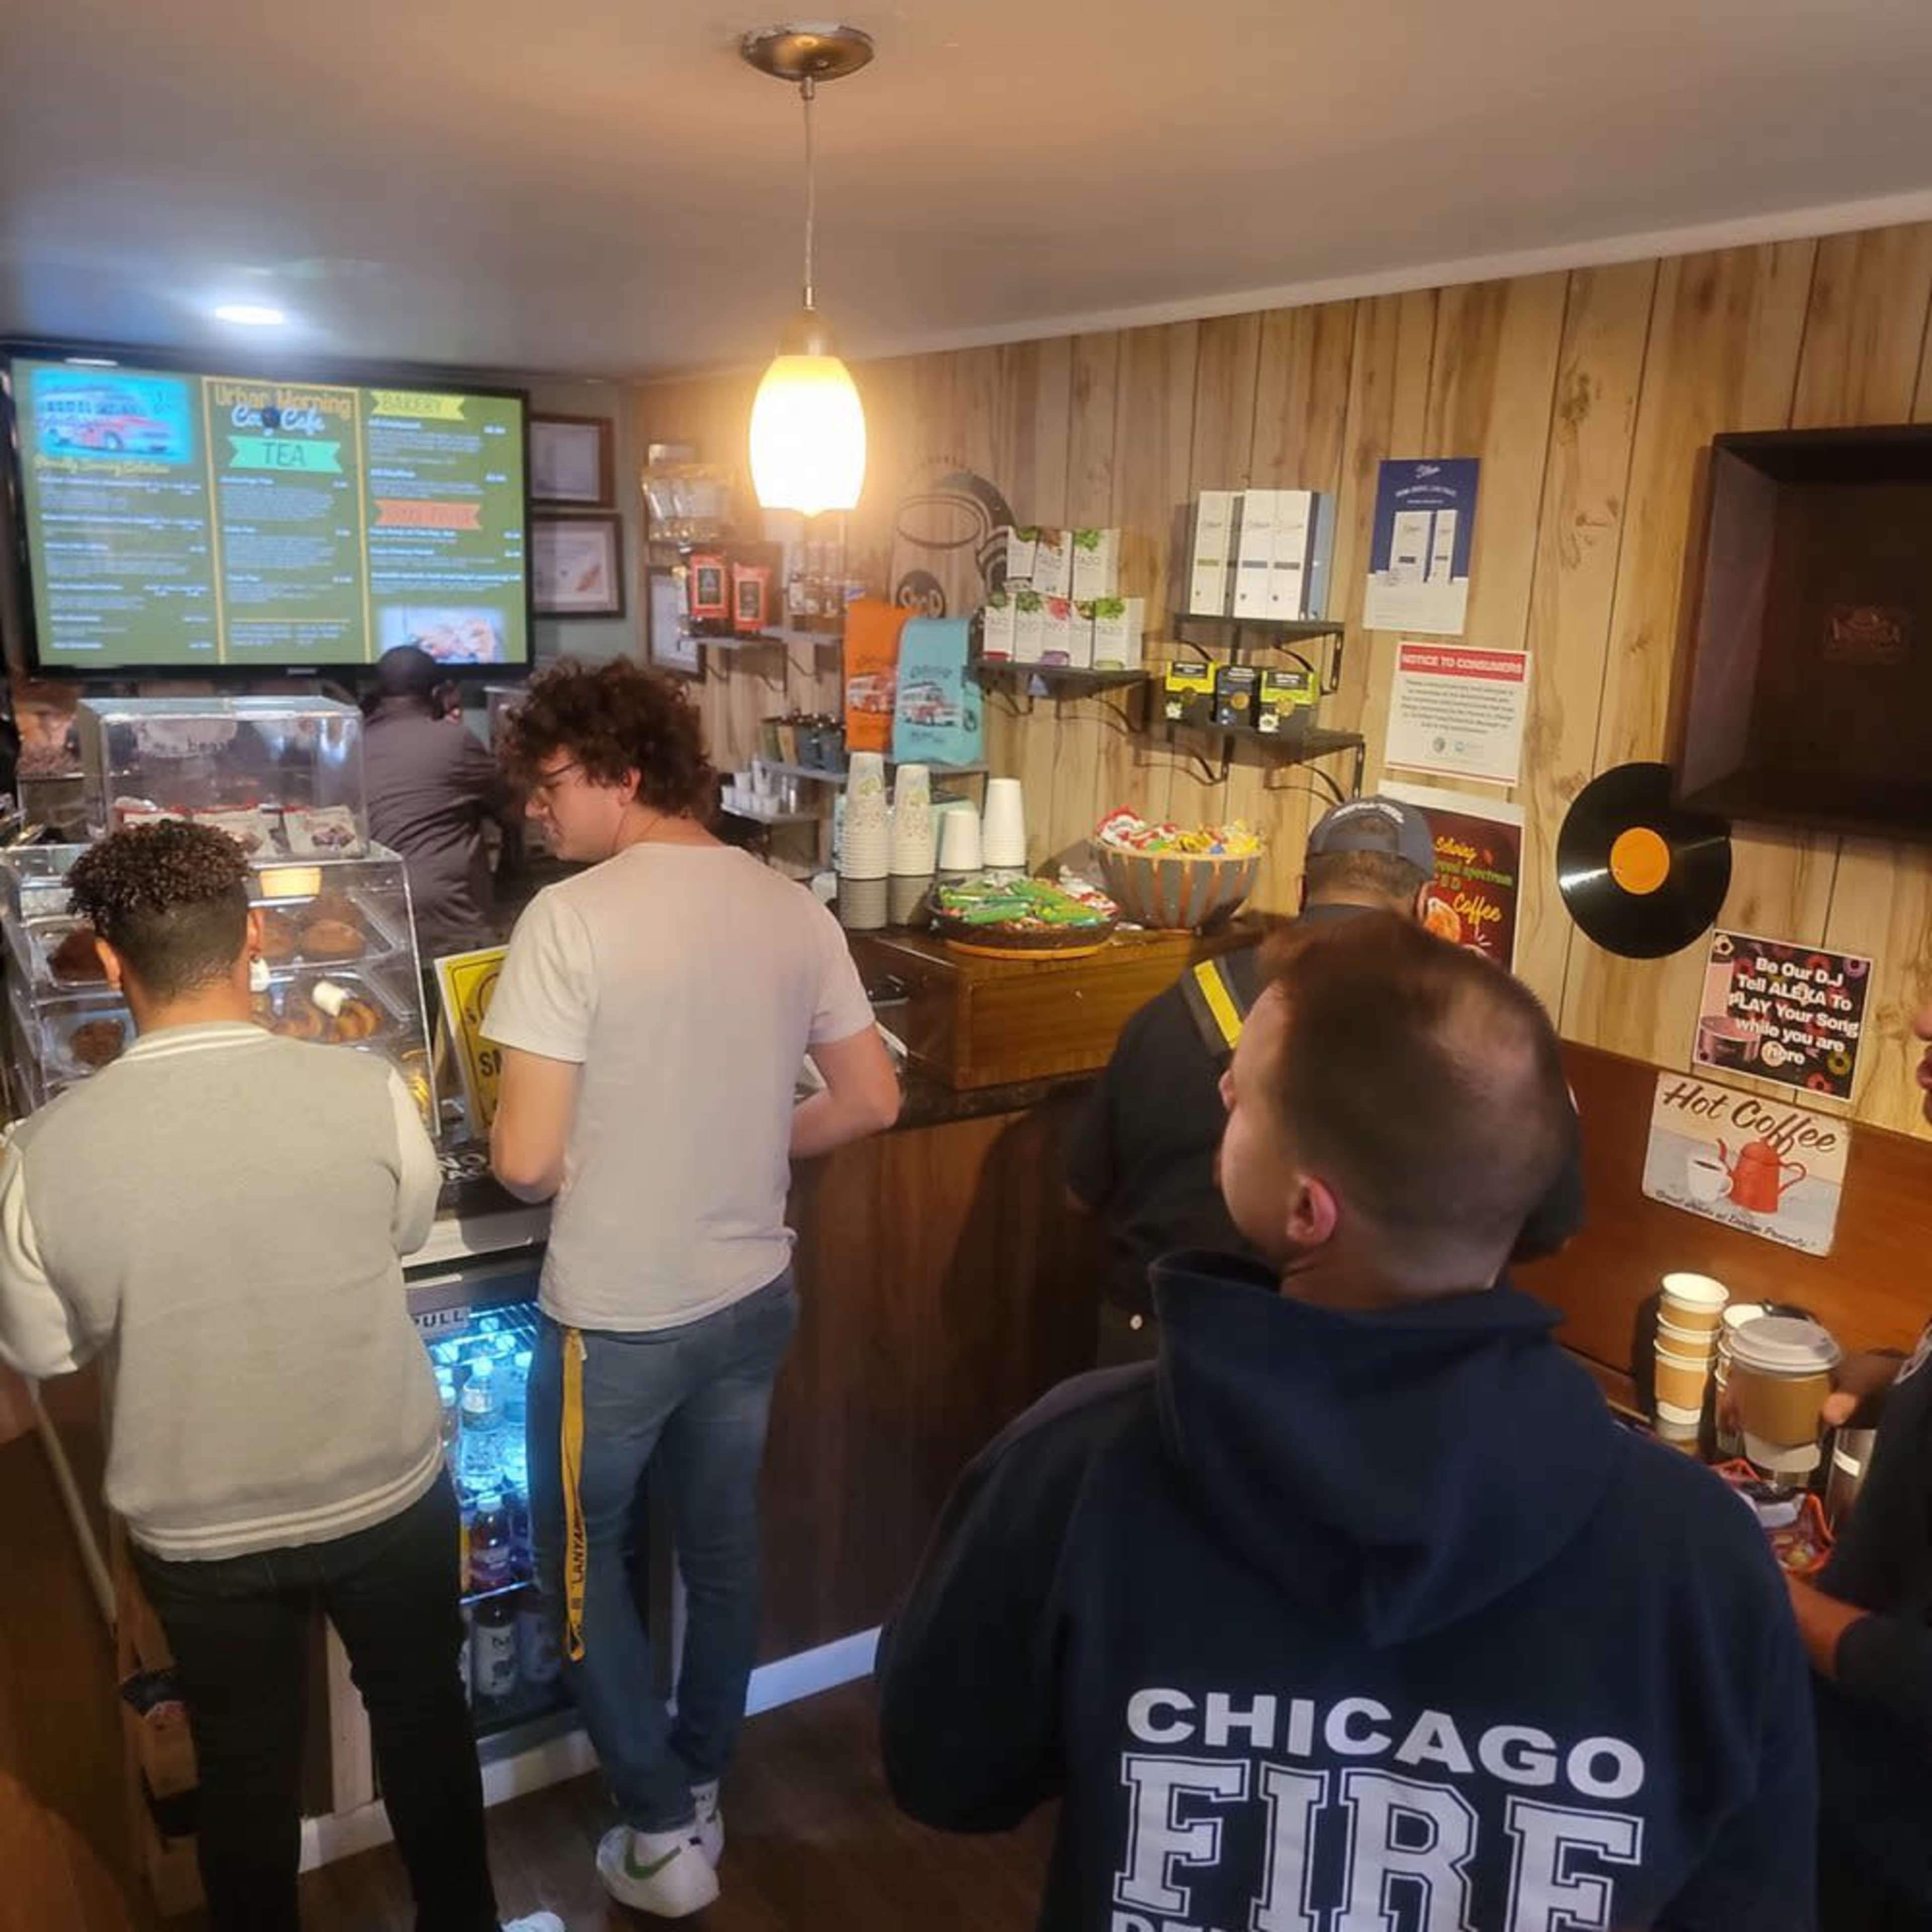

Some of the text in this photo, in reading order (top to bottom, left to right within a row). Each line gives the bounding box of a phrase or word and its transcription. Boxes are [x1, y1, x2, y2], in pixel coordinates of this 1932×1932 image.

[277, 388, 351, 420] Morning
[263, 442, 305, 466] TEA
[1453, 892, 1502, 927] Coffee
[1756, 957, 1779, 974] Be
[1782, 962, 1813, 981] Our
[1737, 973, 1852, 1011] Tell ALEXA To
[1729, 991, 1859, 1038] PLAY Your Song
[1782, 1029, 1812, 1044] you
[1816, 1036, 1845, 1052] are
[1662, 1082, 1837, 1157] Hot Coffee
[1126, 1687, 1644, 1799] CHICAGO
[1112, 1752, 1644, 1932] FIRE
